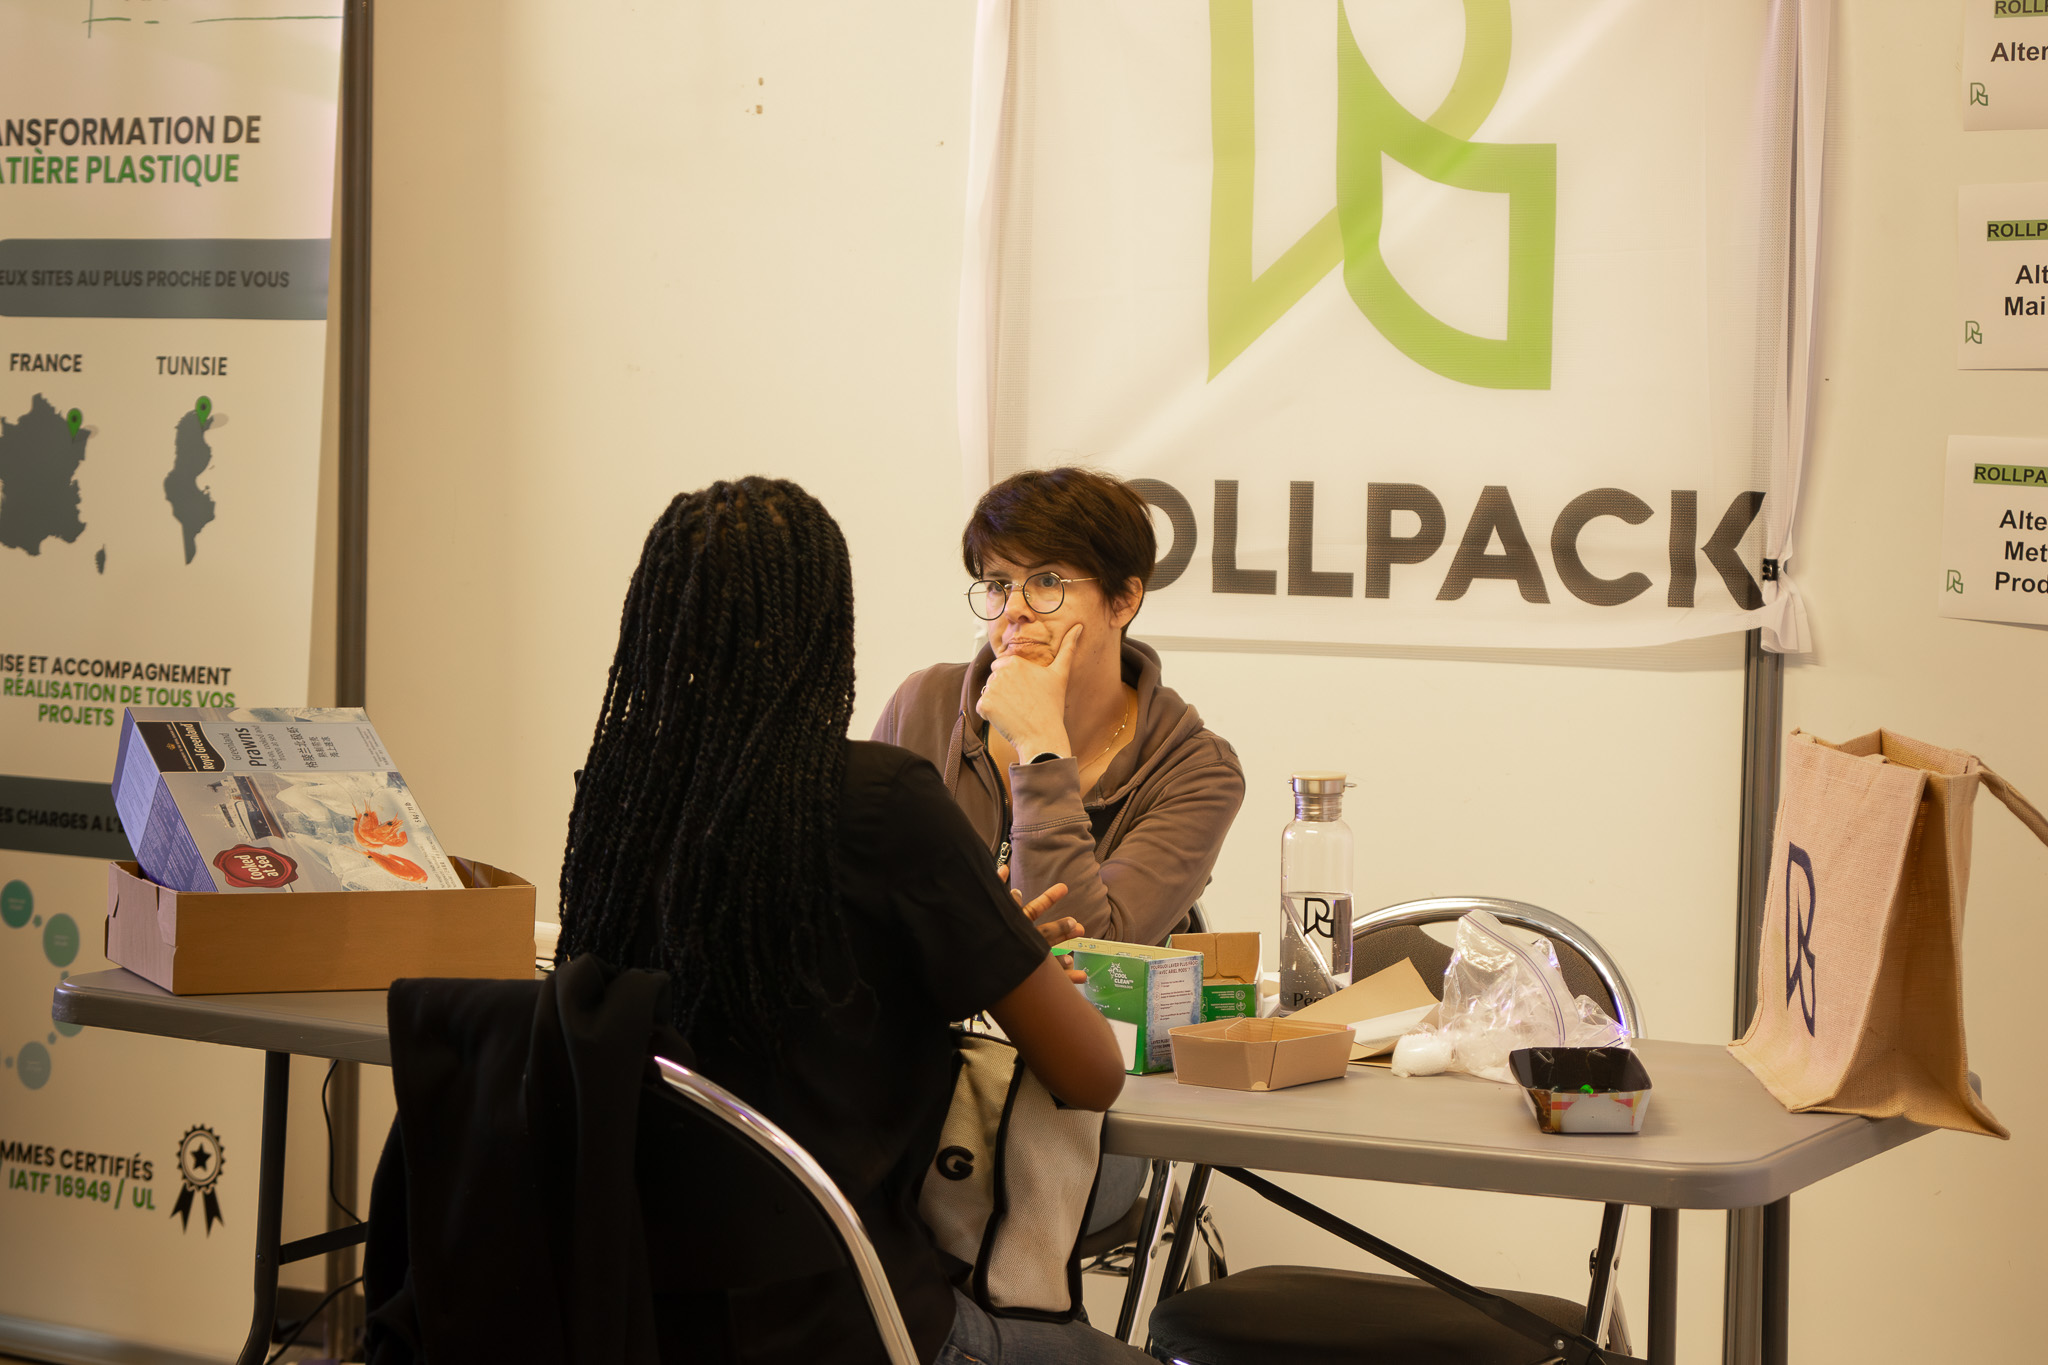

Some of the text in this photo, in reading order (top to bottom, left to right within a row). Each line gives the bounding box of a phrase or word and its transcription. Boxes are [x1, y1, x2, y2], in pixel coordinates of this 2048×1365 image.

[0, 115, 261, 147] NSFORMATION DE
[0, 147, 240, 187] TIÈRE PLASTIQUE
[1987, 222, 2048, 238] ROLLP
[32, 270, 73, 287] SITES
[77, 270, 100, 287] AU
[104, 270, 143, 287] PLUS
[147, 270, 211, 287] PROCHE
[215, 271, 236, 287] DE
[241, 271, 290, 288] VOUS
[2015, 265, 2048, 285] Alt
[2005, 296, 2046, 316] Mai
[10, 353, 82, 373] FRANCE
[156, 356, 228, 376] TUNISIE
[1974, 466, 2048, 484] ROLLPA
[1999, 509, 2048, 531] Alte
[2005, 540, 2048, 563] Met
[29, 656, 48, 674] ET
[52, 657, 231, 686] ACCOMPAGNEMENT
[4, 674, 236, 708] RÉALISATION DE TOUS VOS
[38, 703, 114, 727] PROJETS
[180, 723, 206, 753] Greenland
[235, 728, 267, 766] Prawns
[195, 754, 215, 769] Royal
[17, 808, 88, 830] CHARGES
[91, 816, 102, 831] A
[0, 1139, 154, 1182] MMES CERTIFIÉS
[936, 1146, 975, 1181] G
[9, 1168, 156, 1211] IATF 16949 / UL
